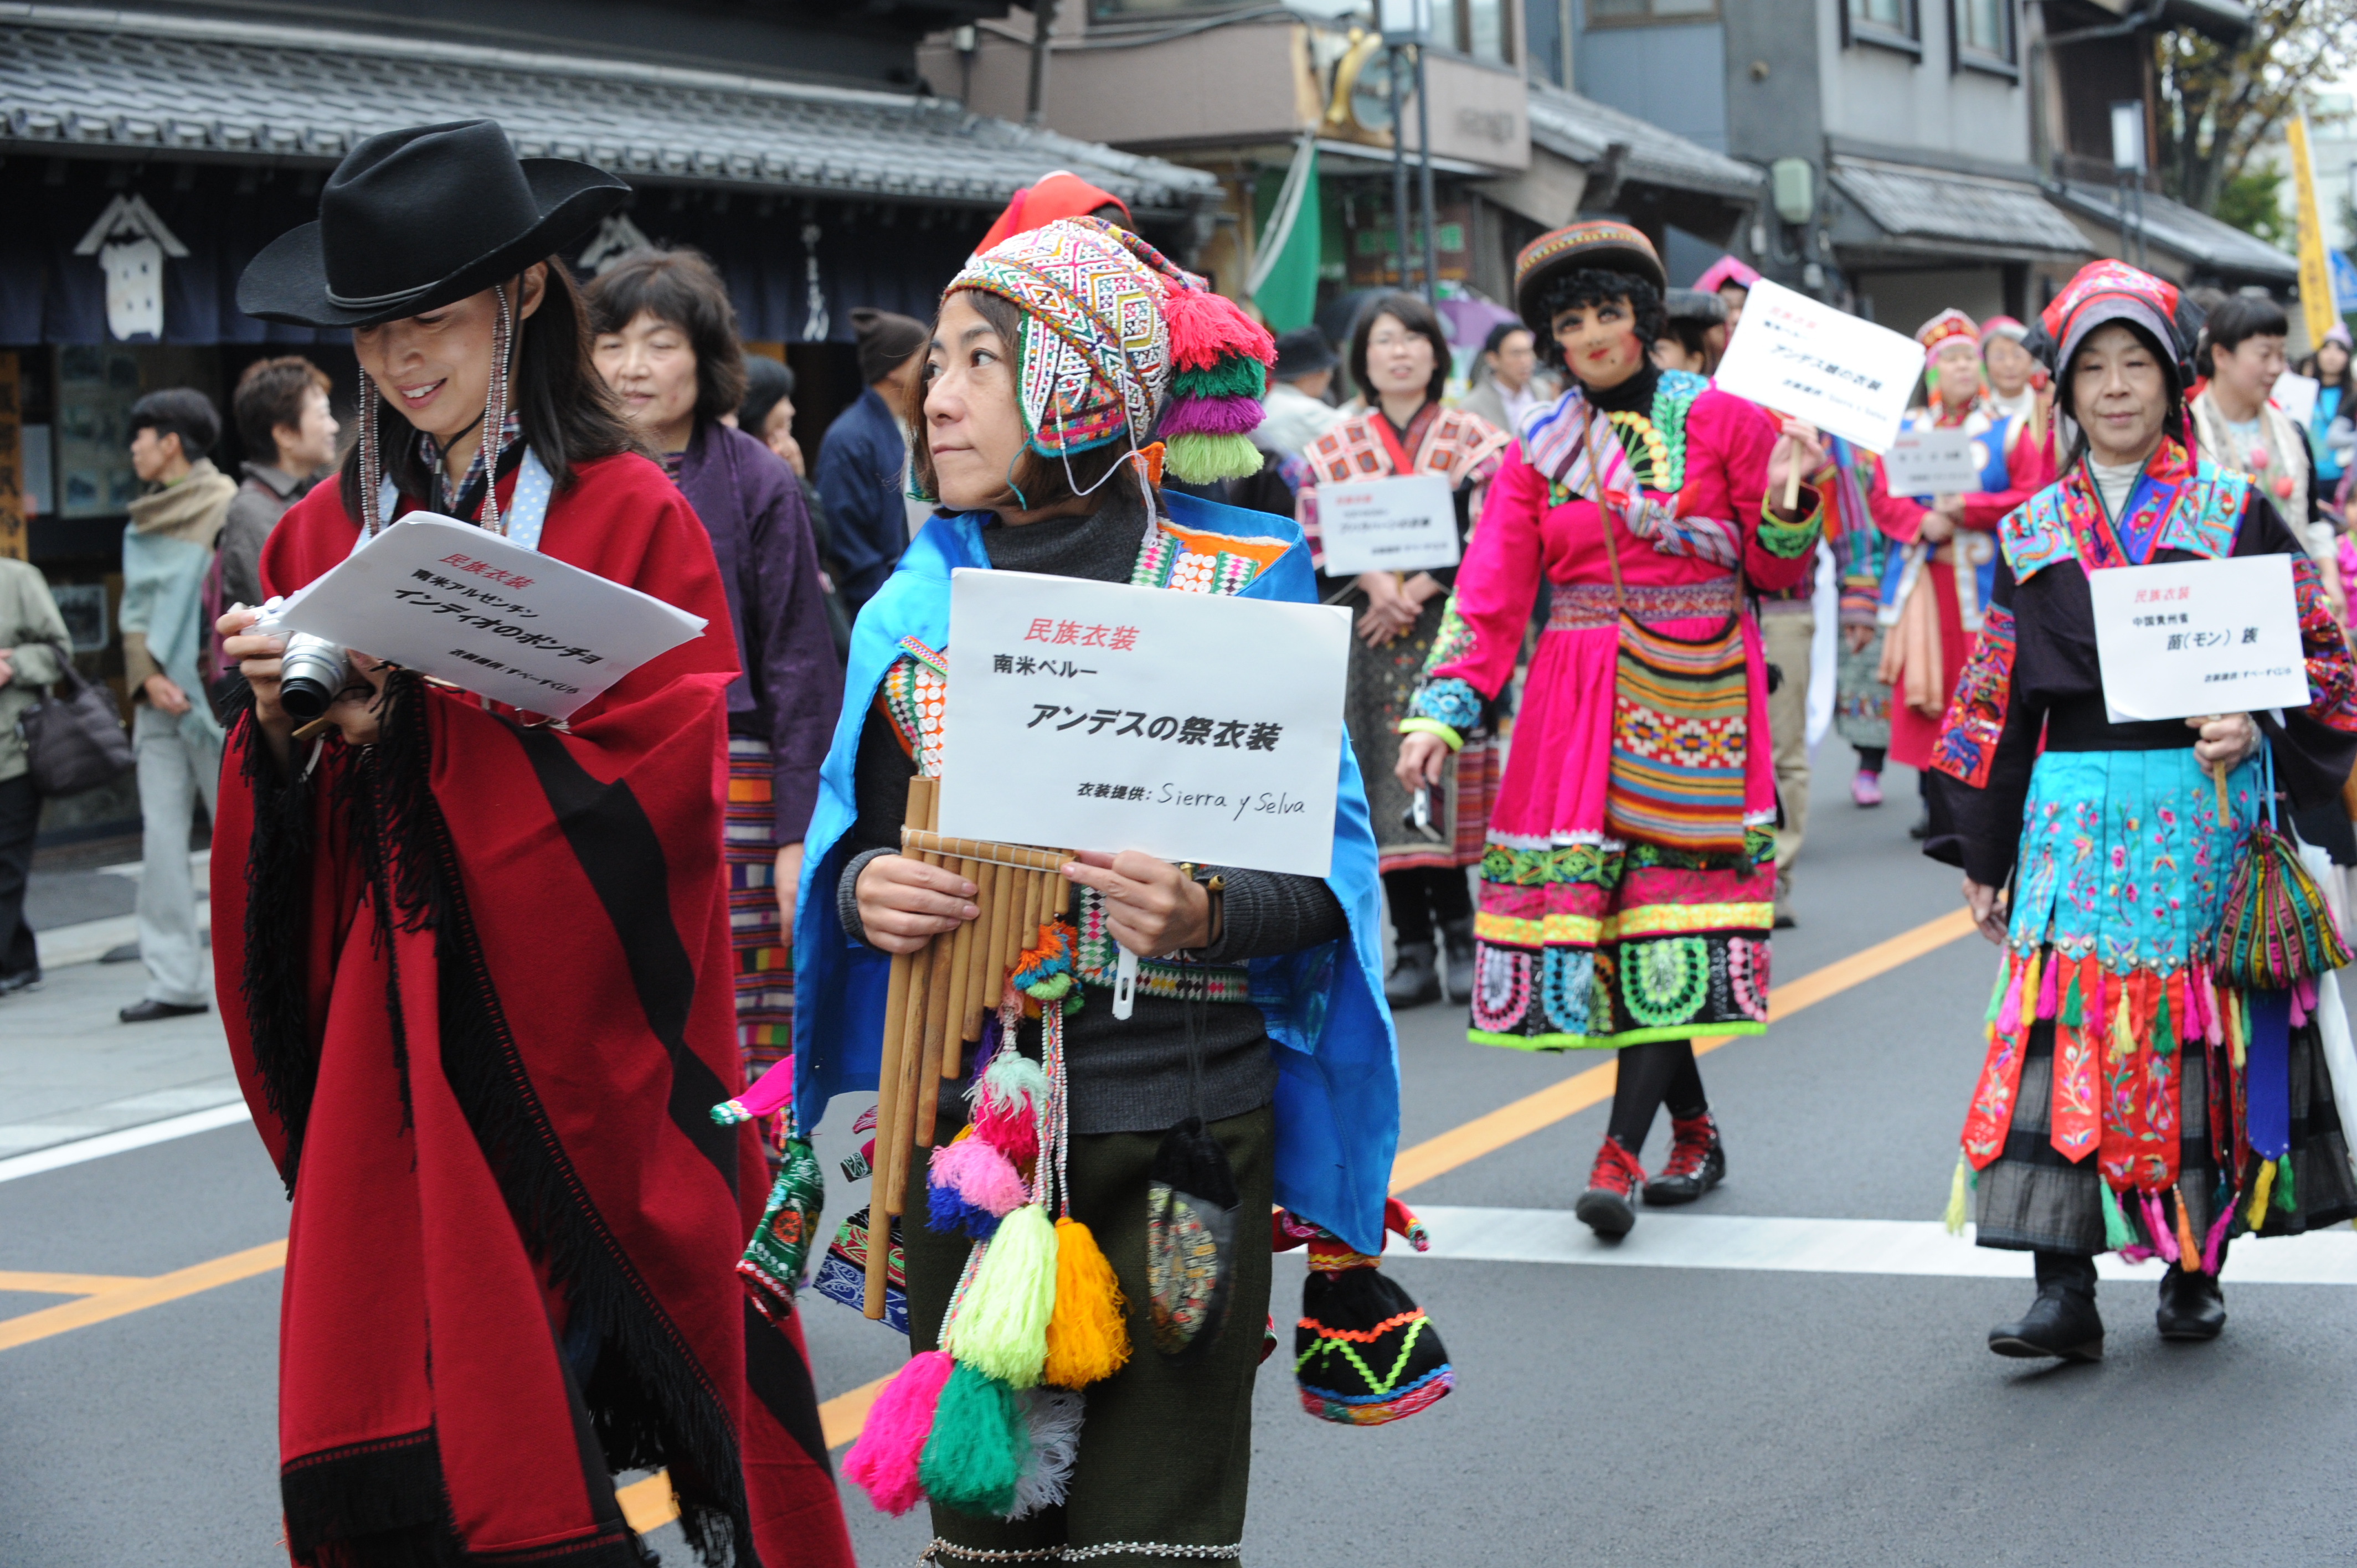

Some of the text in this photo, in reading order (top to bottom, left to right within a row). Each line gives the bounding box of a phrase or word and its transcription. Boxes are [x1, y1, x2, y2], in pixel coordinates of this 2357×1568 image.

[439, 553, 535, 590] 民族衣装
[411, 568, 539, 618] 南米アルゼンチン
[2135, 586, 2190, 603] 民族衣装
[394, 589, 605, 665] インディオのポンチョ
[1024, 618, 1140, 652] 民族衣装
[993, 653, 1098, 679] 南米ペルー
[1027, 704, 1283, 751] アンデスの祭衣装
[1157, 782, 1227, 807] Sierra
[1233, 796, 1251, 822] y
[1254, 792, 1305, 814] Selva
